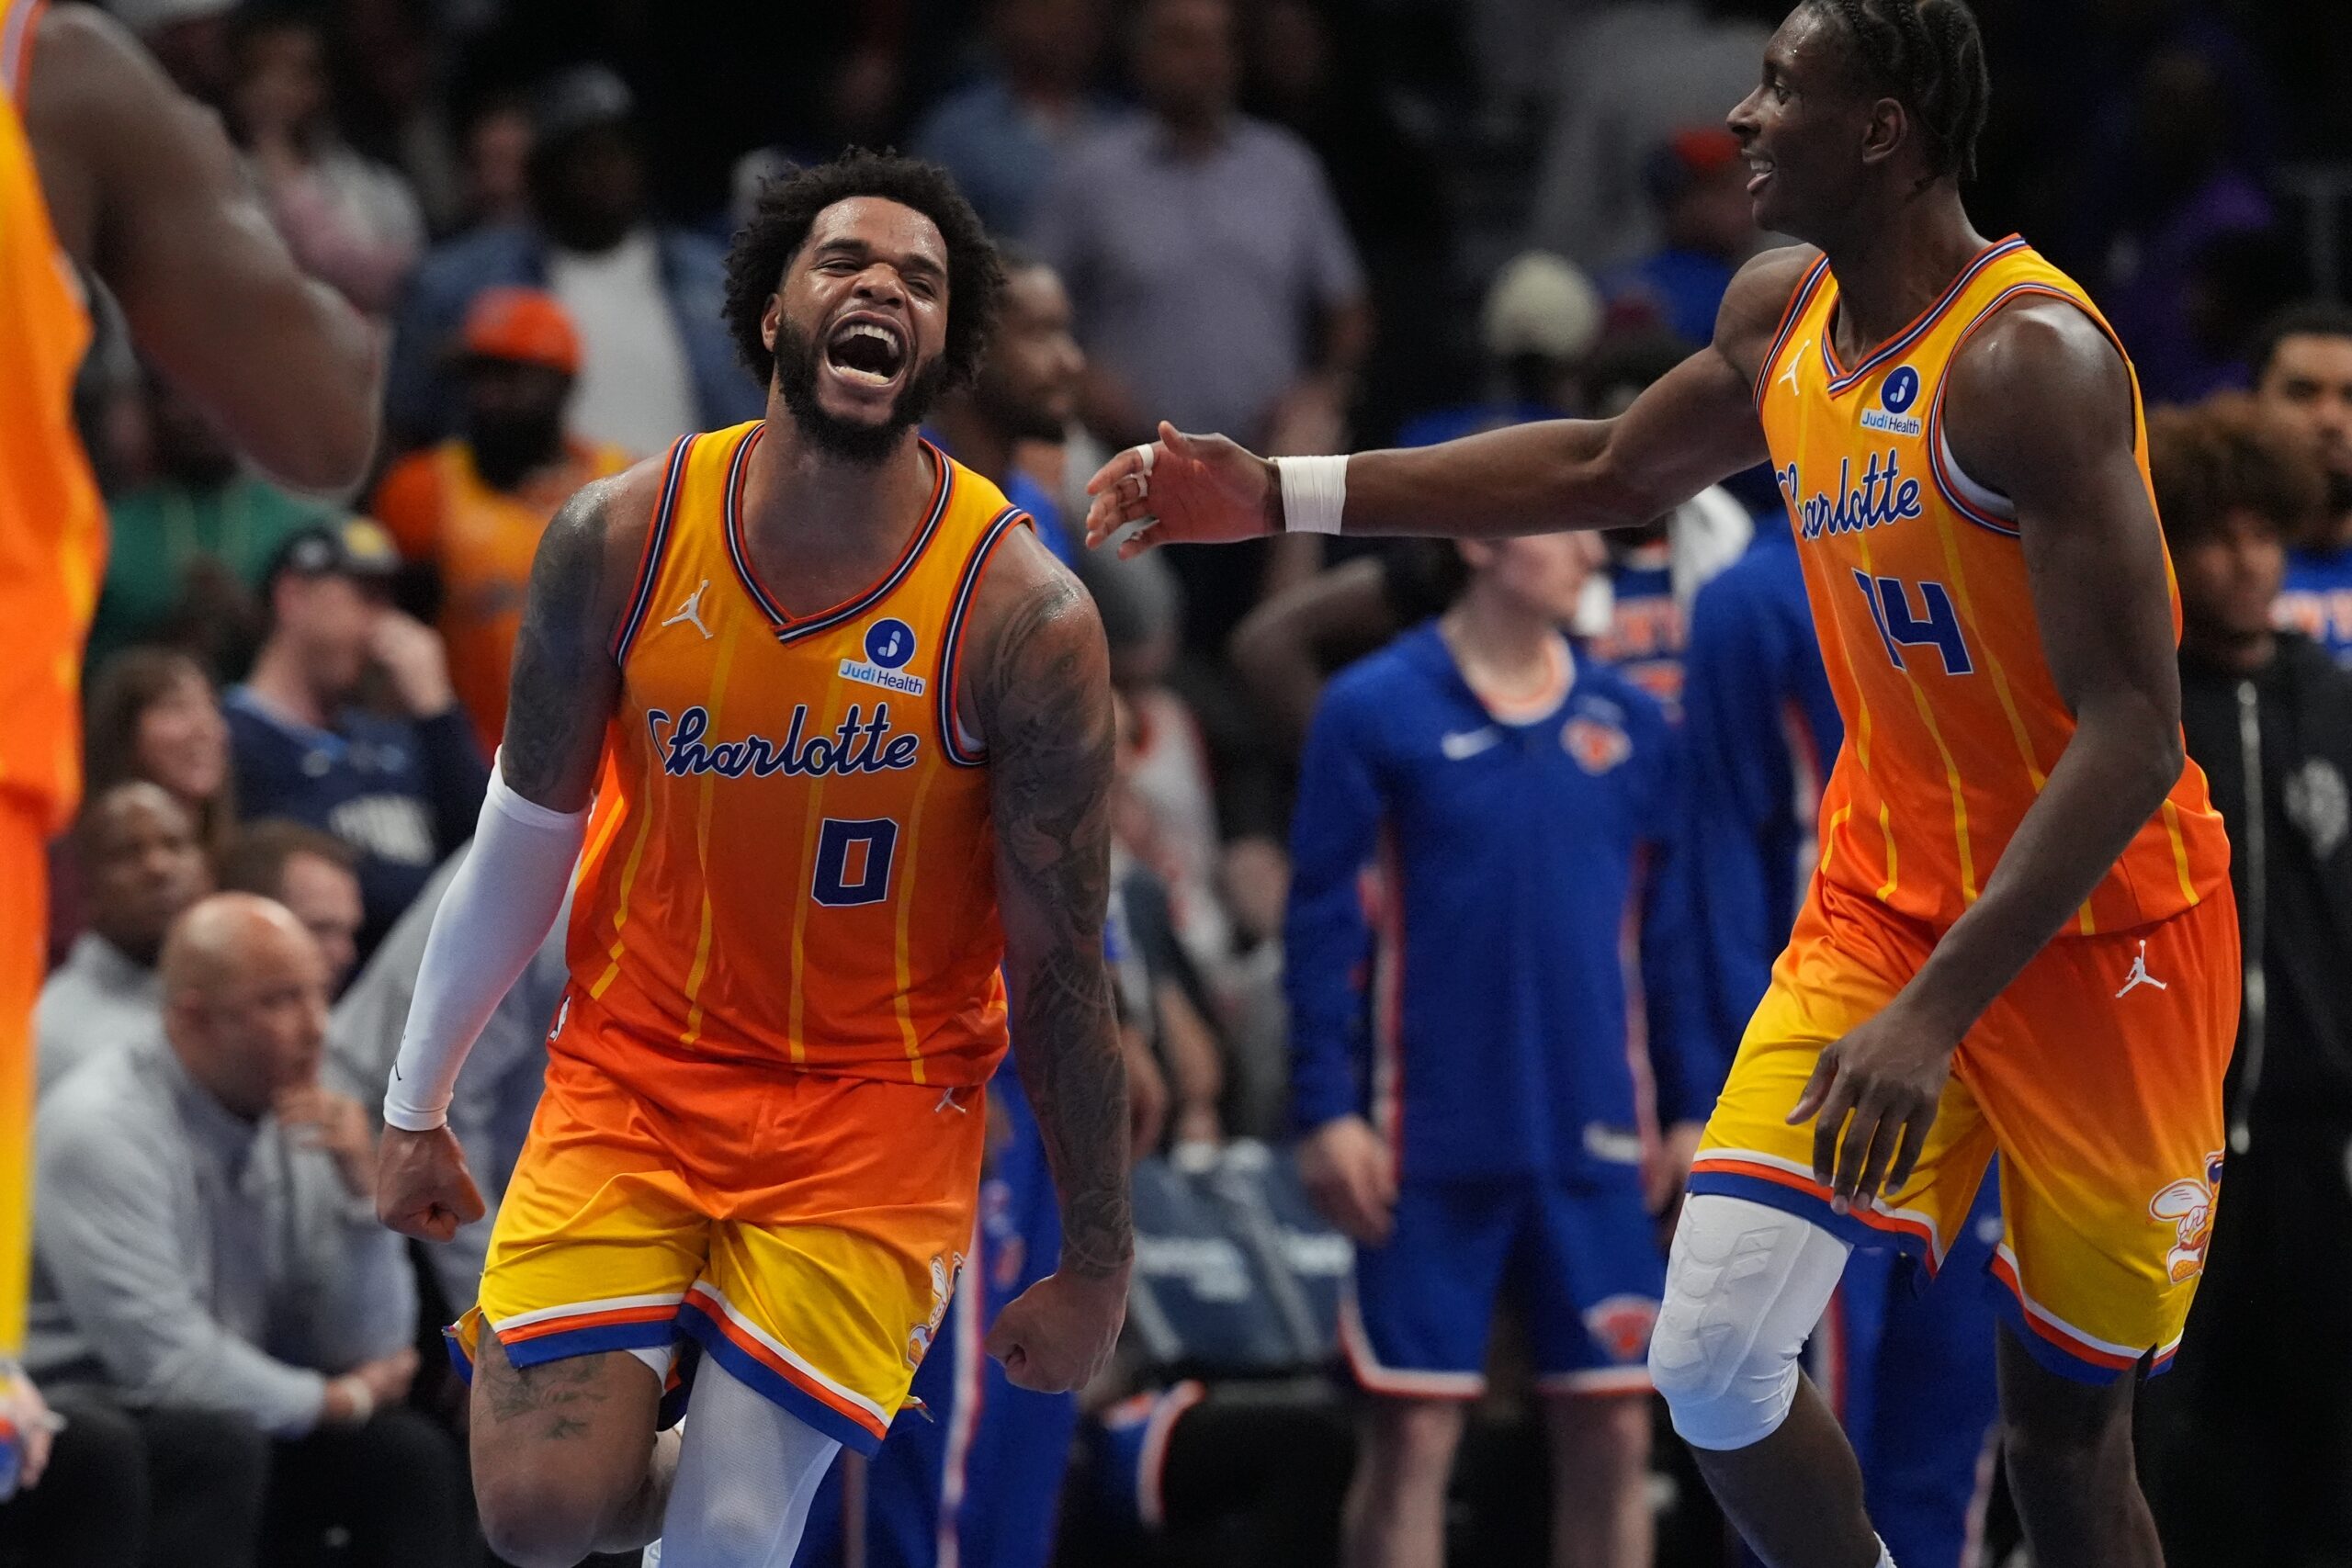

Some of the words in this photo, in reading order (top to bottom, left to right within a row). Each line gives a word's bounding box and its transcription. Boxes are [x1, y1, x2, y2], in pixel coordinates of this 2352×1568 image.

[1861, 412, 1889, 430] Judi
[1888, 416, 1920, 435] Health
[1777, 446, 1923, 541] arlotte
[1851, 567, 1974, 676] 14
[841, 662, 876, 682] Judi
[876, 670, 923, 694] Health
[810, 817, 899, 907] 0
